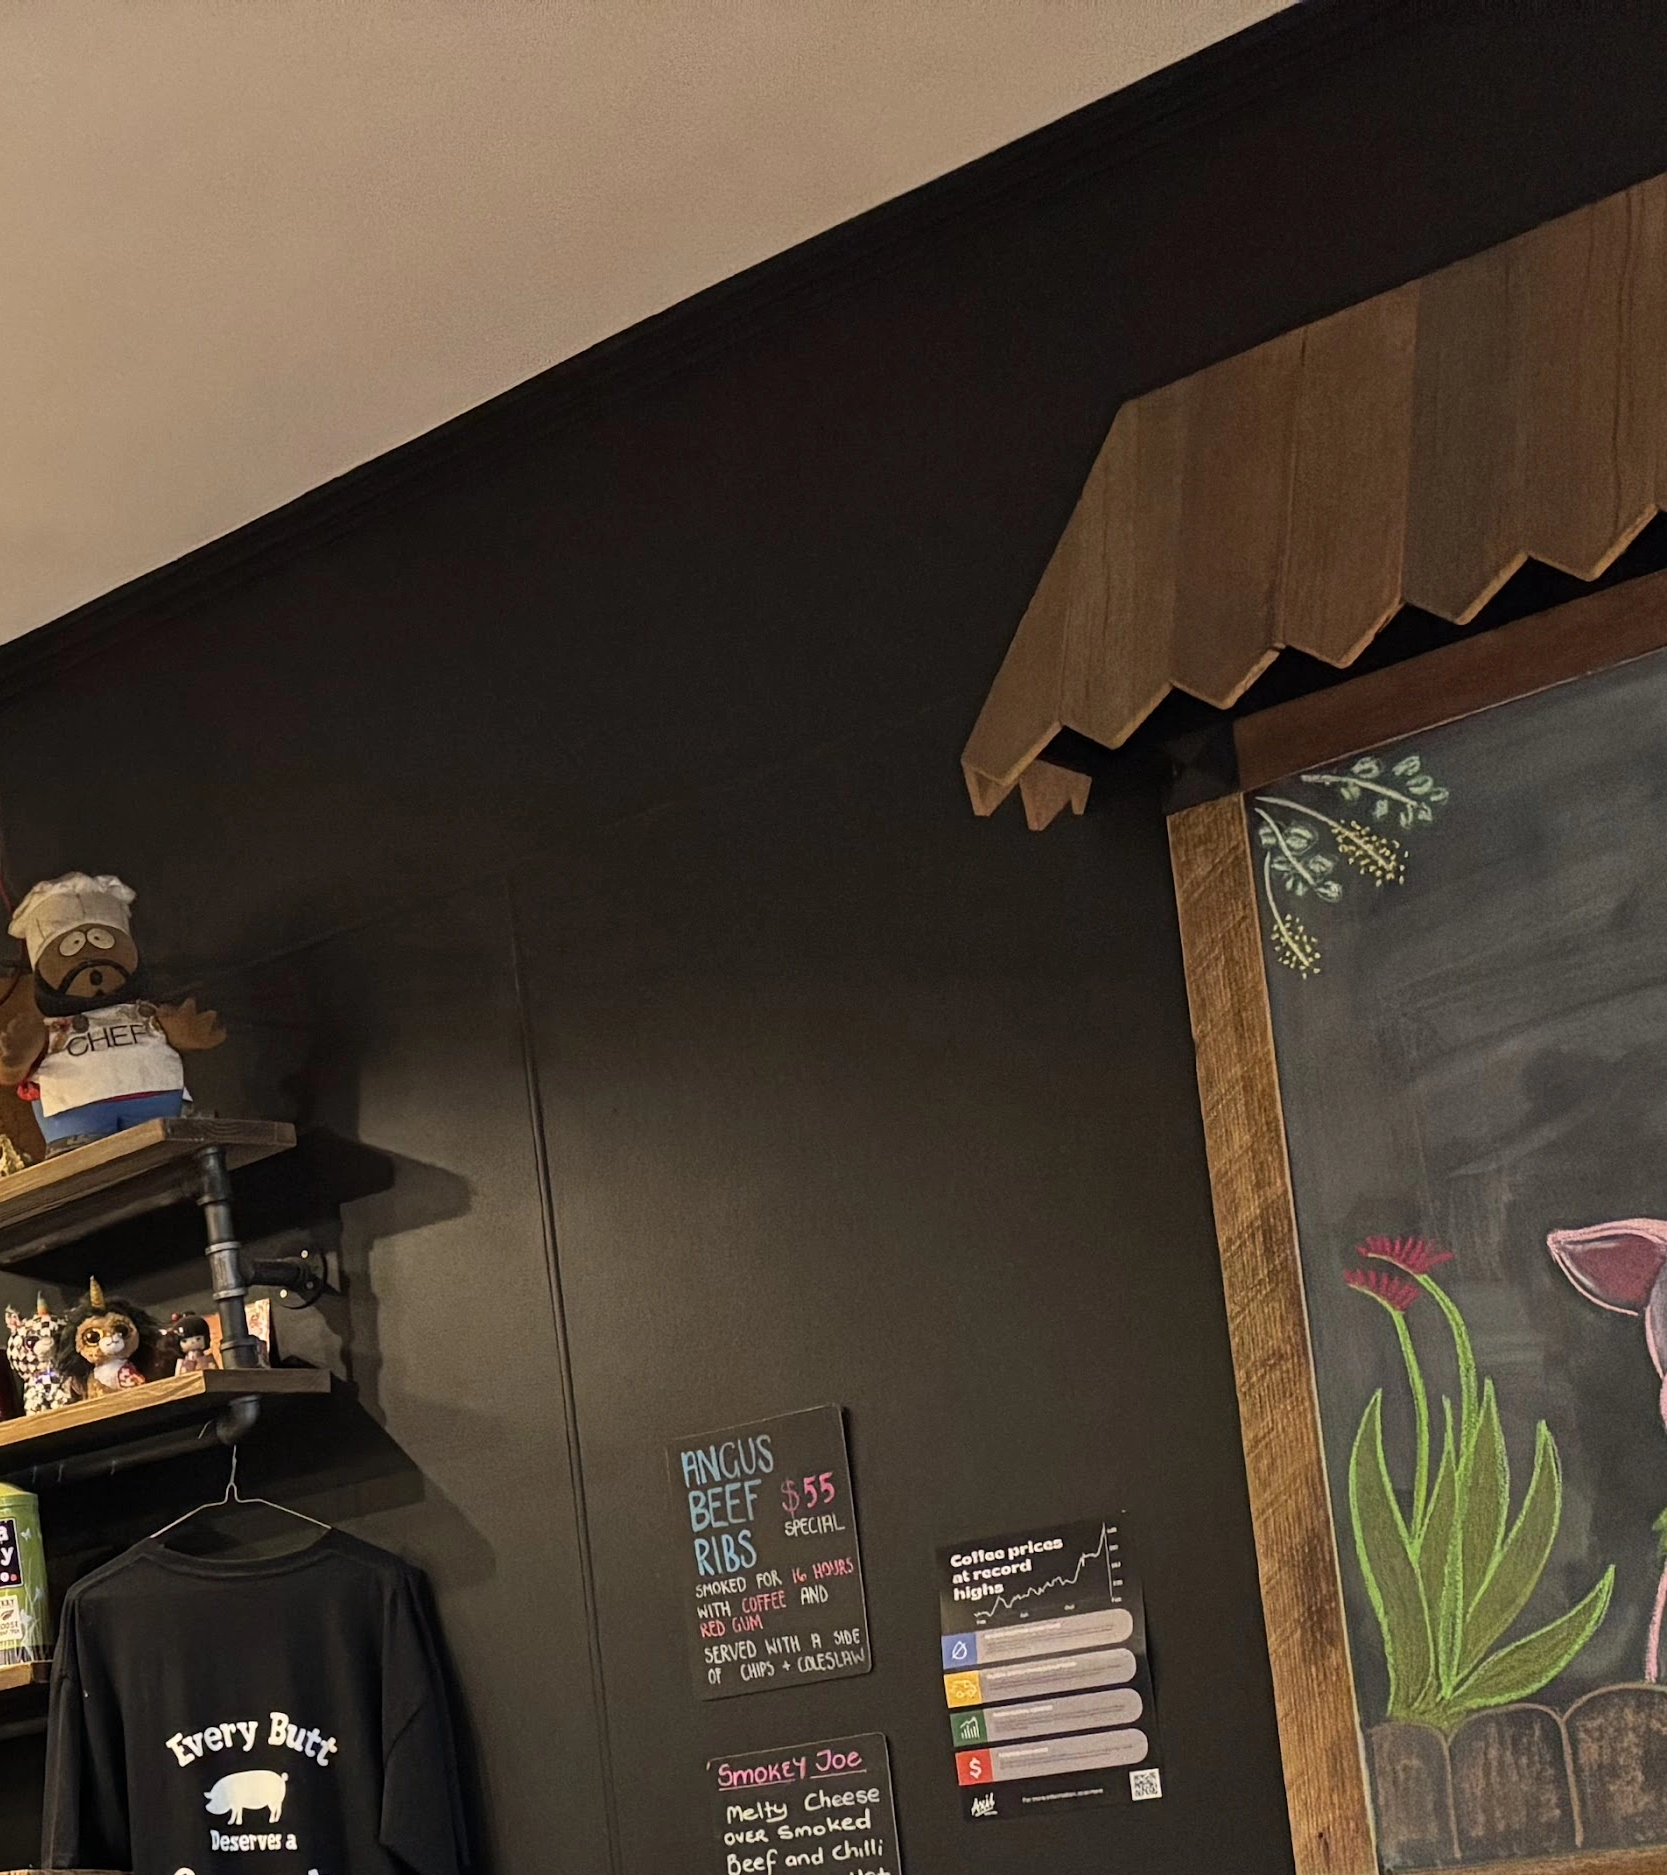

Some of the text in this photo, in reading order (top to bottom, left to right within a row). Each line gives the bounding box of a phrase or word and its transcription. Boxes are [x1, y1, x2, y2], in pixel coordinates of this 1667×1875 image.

[66, 1024, 146, 1057] CHEF
[680, 1434, 774, 1489] ANGUS
[688, 1478, 762, 1532] BEEF
[780, 1471, 837, 1520] $55
[784, 1513, 846, 1537] SPECIAL
[693, 1529, 758, 1577] RIBS
[950, 1537, 1064, 1568] Coffee prices
[695, 1557, 854, 1599] SMOKED FOR 16 HOURS
[952, 1559, 1033, 1585] at record
[697, 1584, 829, 1619] WITH COFFEE AND
[953, 1583, 1005, 1602] highs
[699, 1614, 764, 1639] RED GUM
[704, 1628, 860, 1665] SERVED WITH A SIDE
[708, 1668, 722, 1685] OF
[740, 1661, 775, 1682] CHIPS
[797, 1648, 866, 1674] COLESLAW
[165, 1711, 339, 1768] Every Butt
[815, 1748, 863, 1773] Joe
[726, 1787, 881, 1824] Melty Cheese
[209, 1829, 298, 1852] Deserves a
[777, 1808, 872, 1840] Smoked
[785, 1847, 825, 1868] and
